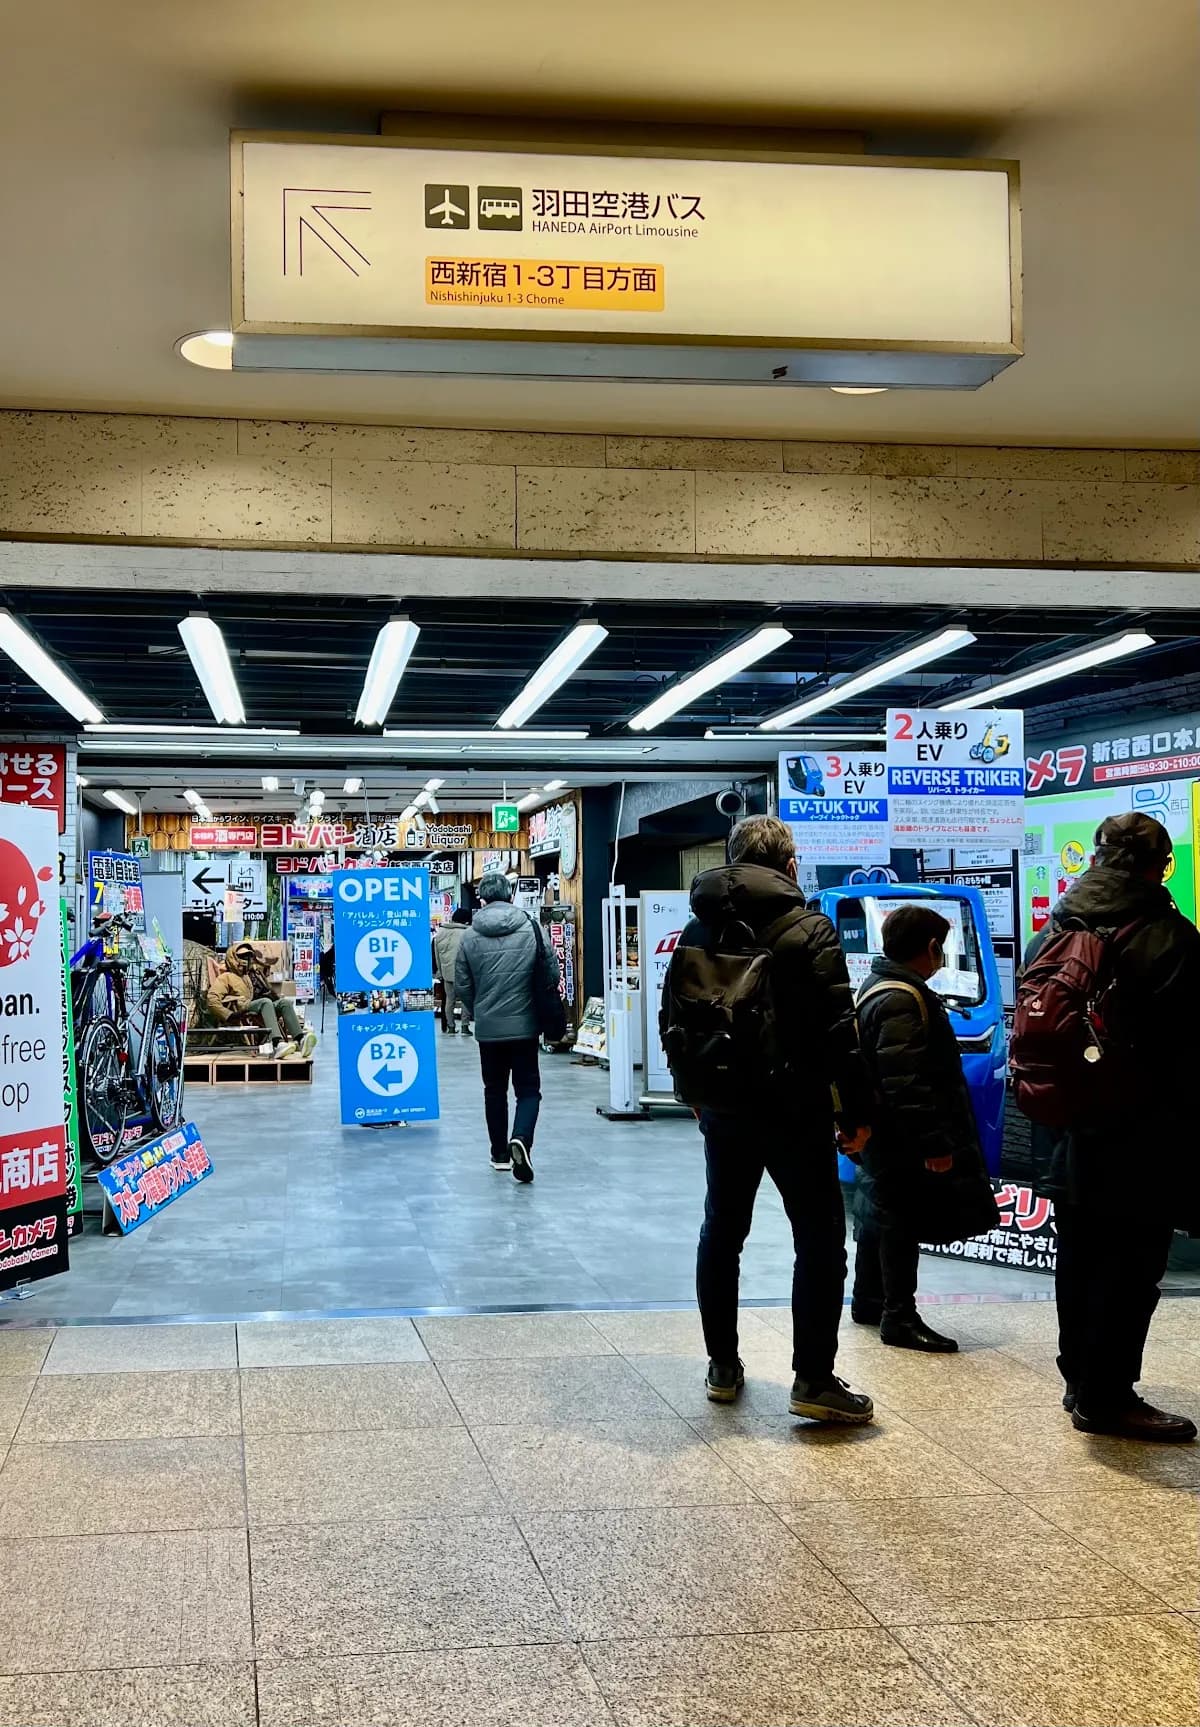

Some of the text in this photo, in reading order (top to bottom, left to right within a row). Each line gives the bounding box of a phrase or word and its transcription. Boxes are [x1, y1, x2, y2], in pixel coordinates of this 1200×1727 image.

[532, 189, 705, 220] 羽田空港バス
[532, 221, 699, 237] HANEDA AirPort Limousine
[430, 261, 656, 292] 西新宿1-3丁目方面
[430, 291, 565, 305] Nishishinjuku 1-3 Chome
[893, 714, 968, 740] 2人乗り
[917, 744, 943, 761] EV
[826, 756, 885, 777] 3人乗り
[892, 769, 1021, 786] REVERSE TRIKER
[0, 778, 54, 799] ース
[844, 780, 865, 794] EV
[789, 801, 843, 814] EV-TUK
[848, 801, 880, 814] TUK
[426, 824, 472, 834] Yodobashi
[431, 835, 465, 845] Liquor
[92, 856, 141, 882] 電動自転車
[338, 877, 423, 903] OPEN
[653, 904, 665, 913] 9F
[369, 936, 399, 953] B1F
[0, 993, 40, 1016] an.
[371, 1043, 406, 1060] B2F
[0, 1142, 59, 1194] 商店
[31, 1244, 58, 1260] Camera
